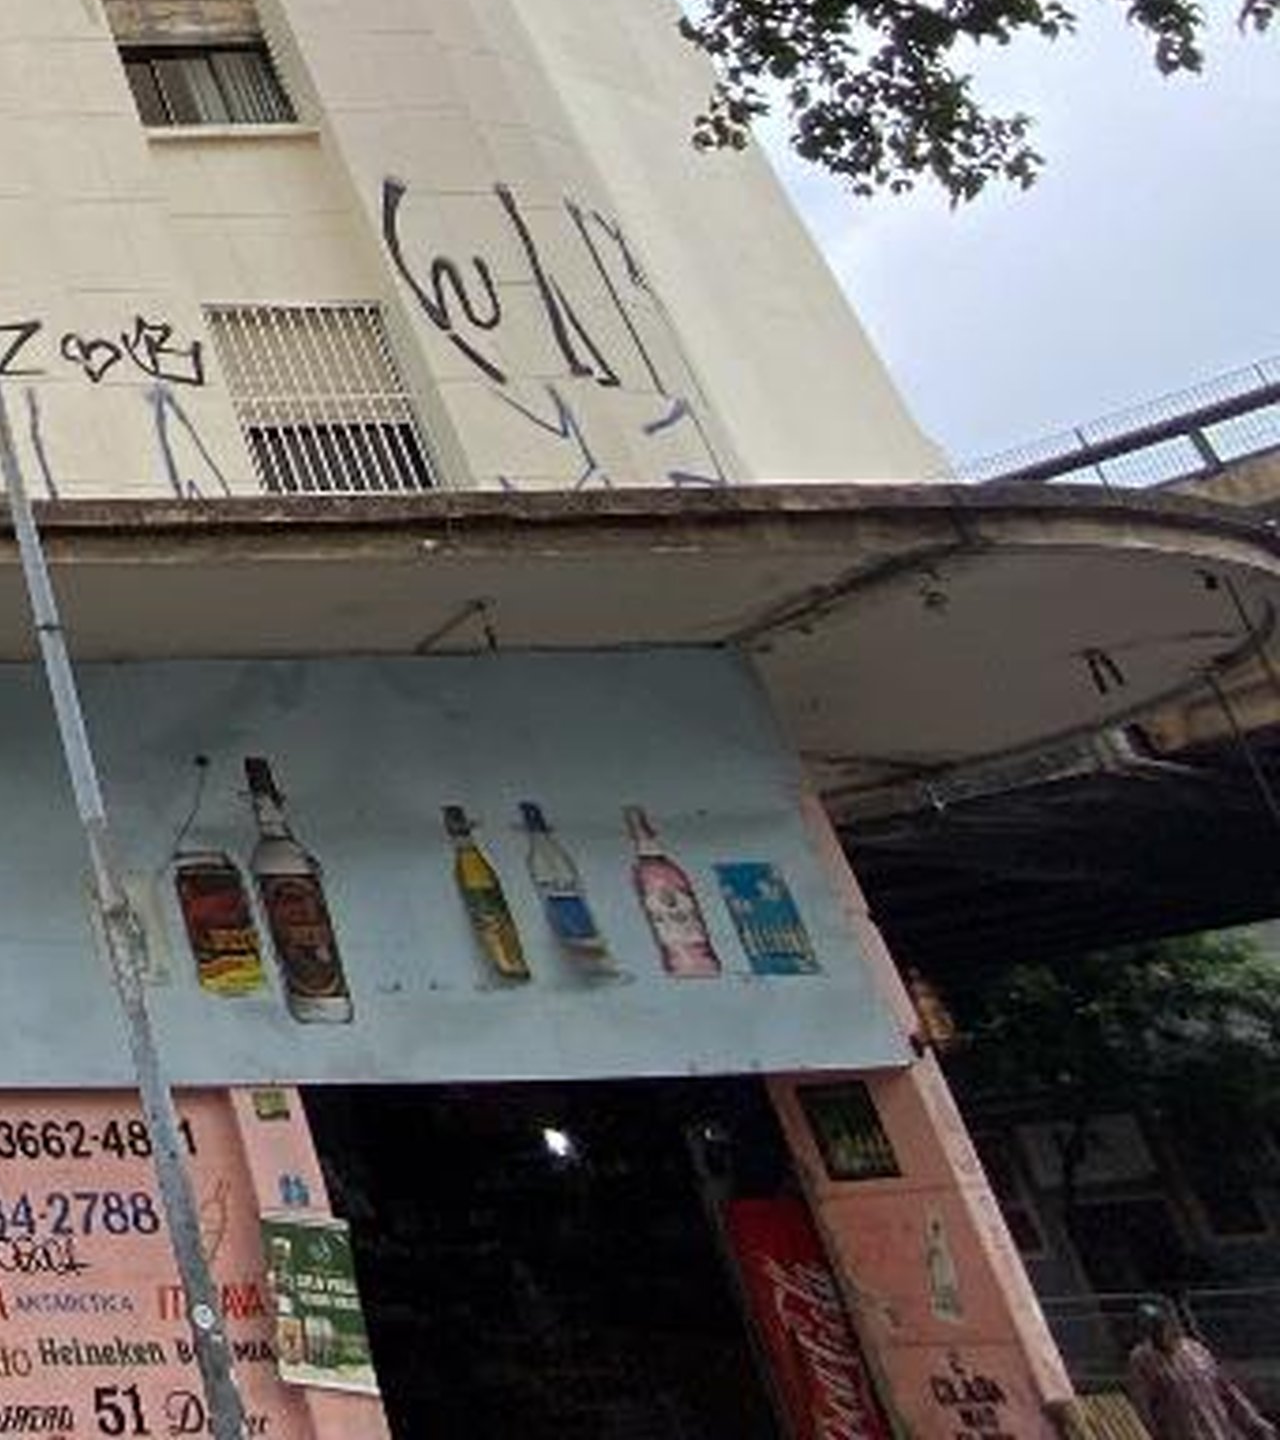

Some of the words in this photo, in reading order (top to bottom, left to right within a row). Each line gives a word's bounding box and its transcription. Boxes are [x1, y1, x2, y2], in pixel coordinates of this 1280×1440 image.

[158, 1283, 267, 1321] ITAVA
[39, 1337, 167, 1367] Heineken
[93, 1383, 151, 1437] 51
